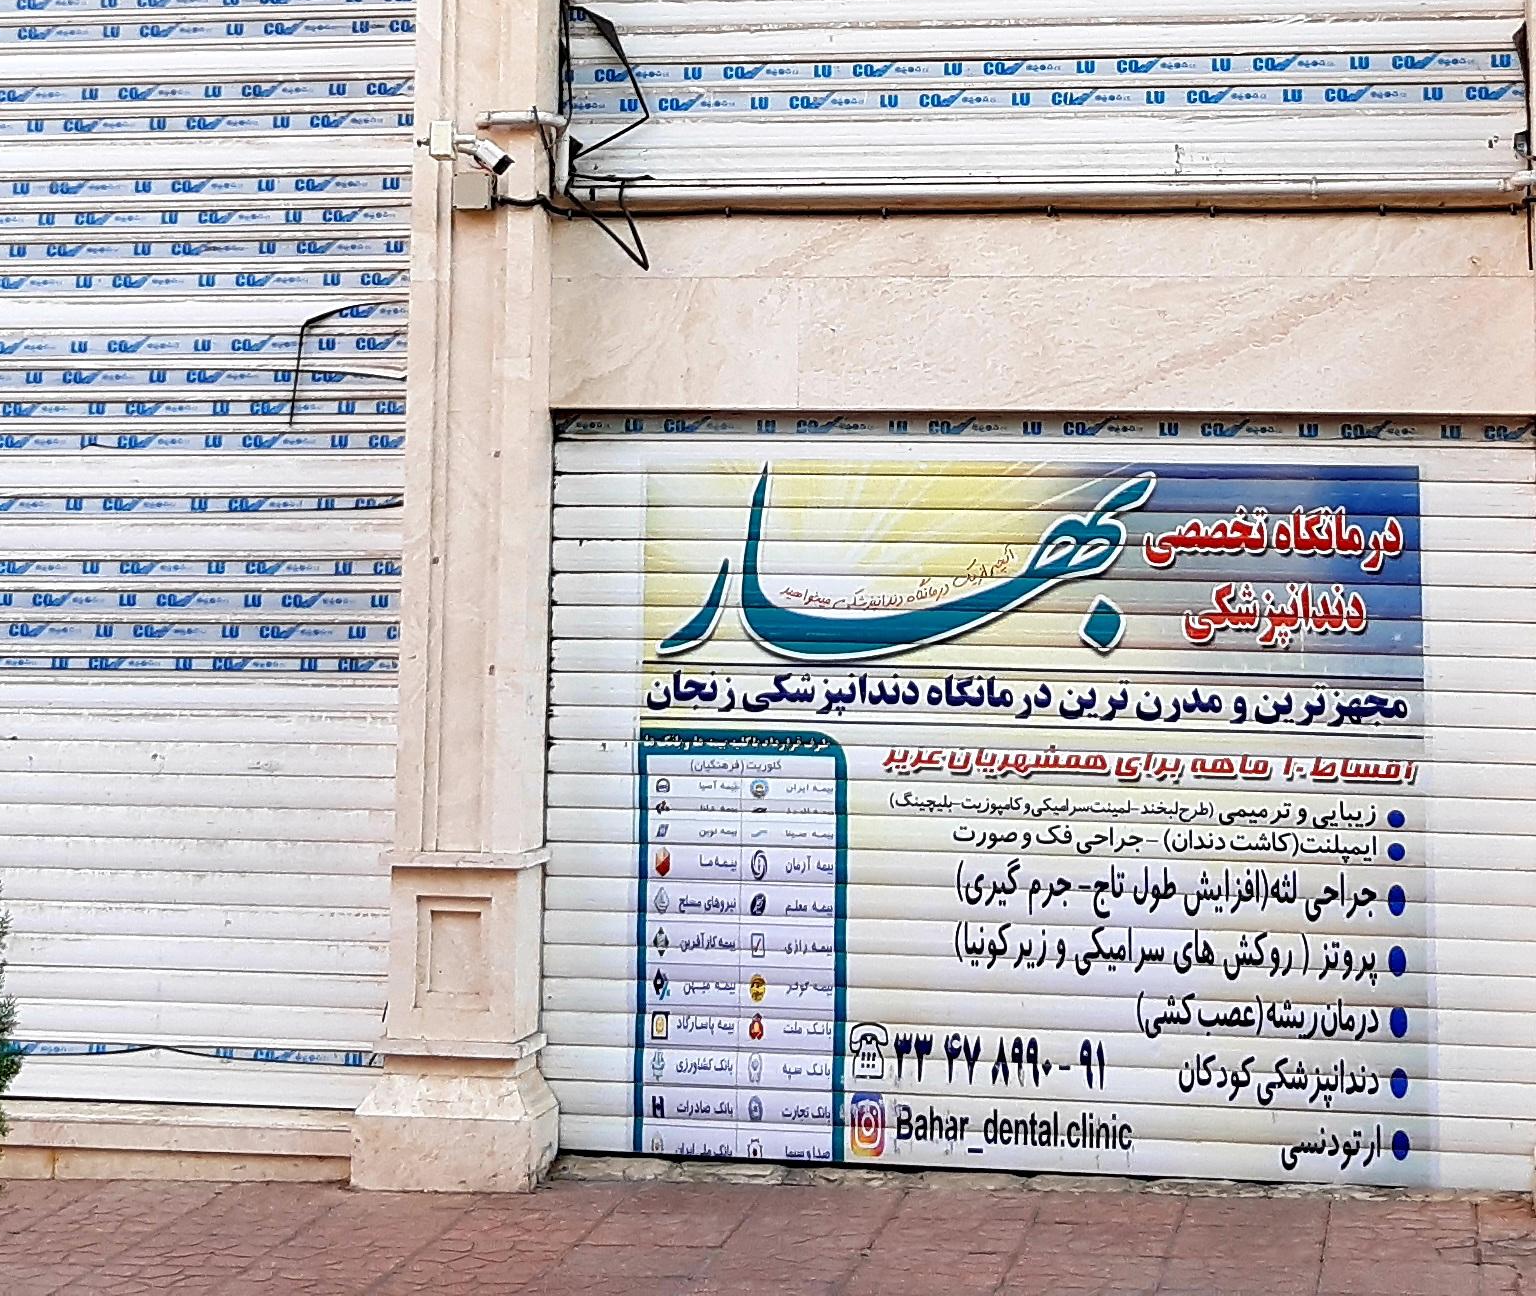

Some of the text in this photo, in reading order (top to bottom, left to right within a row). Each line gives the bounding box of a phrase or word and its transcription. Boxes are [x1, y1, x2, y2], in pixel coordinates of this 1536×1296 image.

[1143, 505, 1404, 571] درمانگاه تخصصی
[657, 463, 1158, 661] بهار
[1182, 582, 1368, 648] دندانپزشکی
[646, 669, 735, 713] زنجان
[742, 672, 919, 716] دندانپزشکی
[927, 674, 1052, 718] درمانگاه
[1060, 679, 1130, 721] ترین
[1136, 687, 1223, 722] مدرن
[1230, 695, 1247, 724] و
[1036, 825, 1072, 845] فک
[1218, 802, 1291, 825] ترمیمی
[1313, 801, 1378, 829] زیبایی
[953, 825, 1018, 849] صورت
[1029, 878, 1072, 915] جرم
[1133, 866, 1176, 913] طول
[1306, 872, 1377, 921] جراحی
[1056, 938, 1066, 968] و
[1075, 926, 1164, 975] سرامیکی
[1174, 929, 1214, 974] های
[1319, 941, 1377, 986] پروتز
[1266, 1000, 1318, 1039] ریشه
[1321, 999, 1379, 1040] درمان
[1179, 1054, 1380, 1108] دندانپزشکی کودکان
[896, 1104, 1133, 1154] Bahar_dental.clinic
[1281, 1124, 1382, 1170] ارتودنسی
